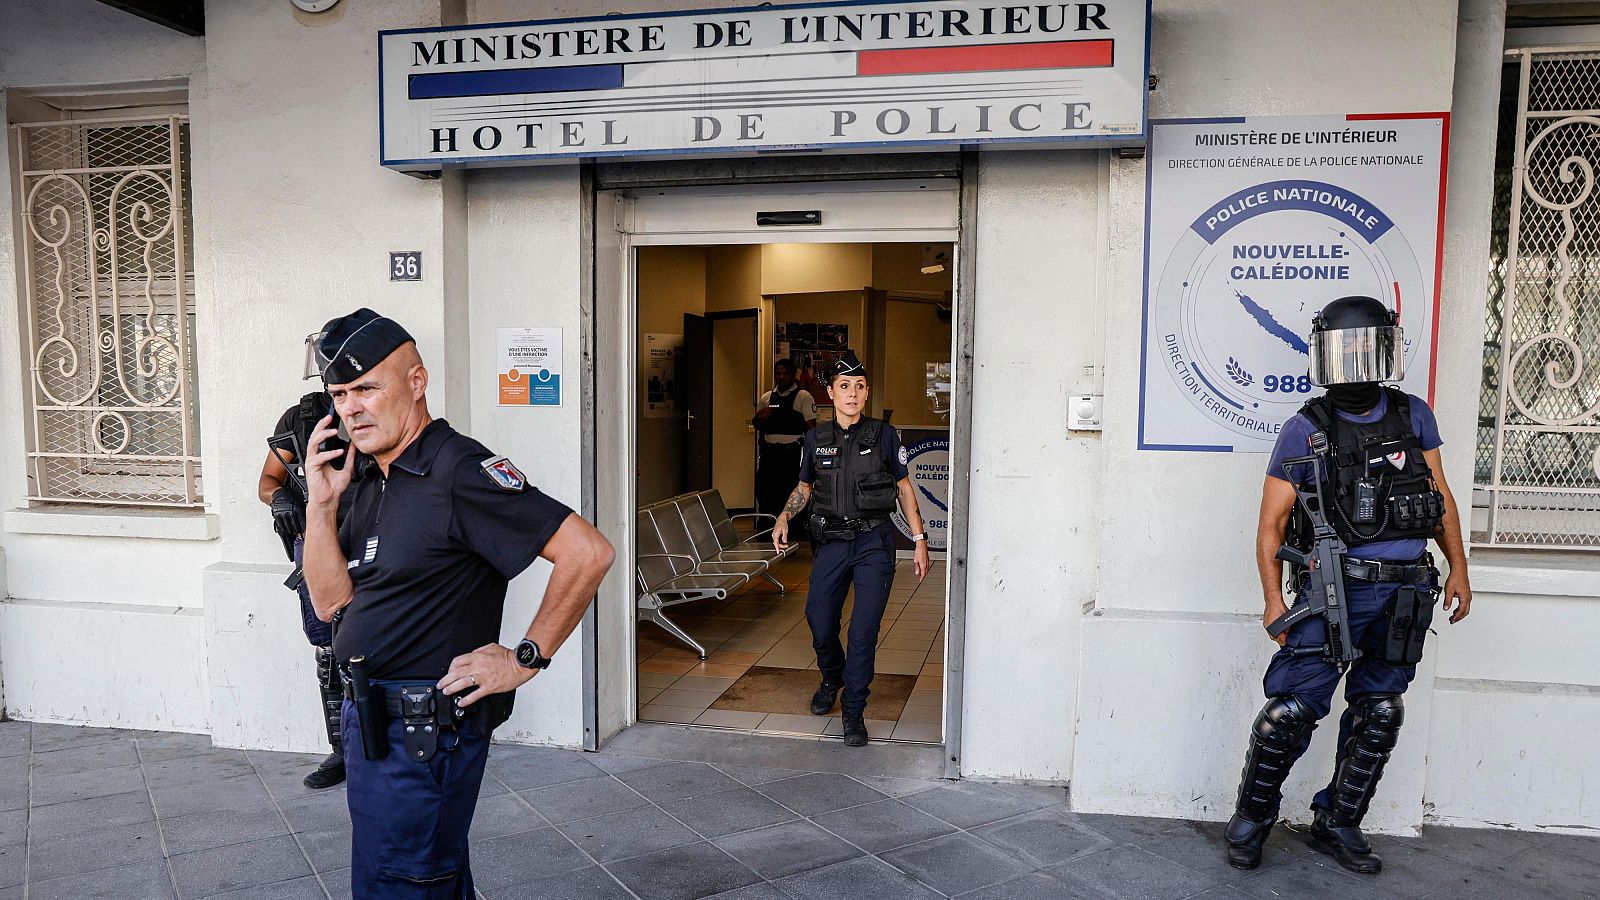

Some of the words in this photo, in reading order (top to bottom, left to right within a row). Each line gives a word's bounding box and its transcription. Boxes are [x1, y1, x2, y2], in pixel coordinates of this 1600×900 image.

[412, 25, 665, 67] MINISTERE
[693, 19, 753, 49] DE
[780, 3, 1110, 45] L'INTERIEUR
[430, 119, 628, 153] HOTEL
[691, 113, 765, 143] DE
[830, 102, 1093, 137] POLICE
[1195, 129, 1277, 147] MINISTÈRE
[1281, 132, 1301, 145] DE
[1305, 127, 1397, 144] L'INTÉRIEUR
[1168, 158, 1225, 169] DIRECTION
[1227, 155, 1284, 168] GÉNÉRALE
[1287, 157, 1301, 167] DE
[1304, 156, 1318, 167] LA
[1320, 156, 1357, 167] POLICE
[1360, 154, 1424, 166] NATIONALE
[1205, 191, 1269, 231] POLICE
[1273, 188, 1378, 230] NATIONALE
[1232, 245, 1349, 259] NOUVELLE-
[394, 256, 418, 277] 36
[1230, 262, 1349, 280] CALÉDONIE
[1165, 334, 1201, 394] DIRECTION
[1200, 391, 1281, 434] TERRITORIALE
[1263, 375, 1312, 394] 988
[906, 441, 932, 458] POLICE
[916, 464, 949, 472] NOUVE
